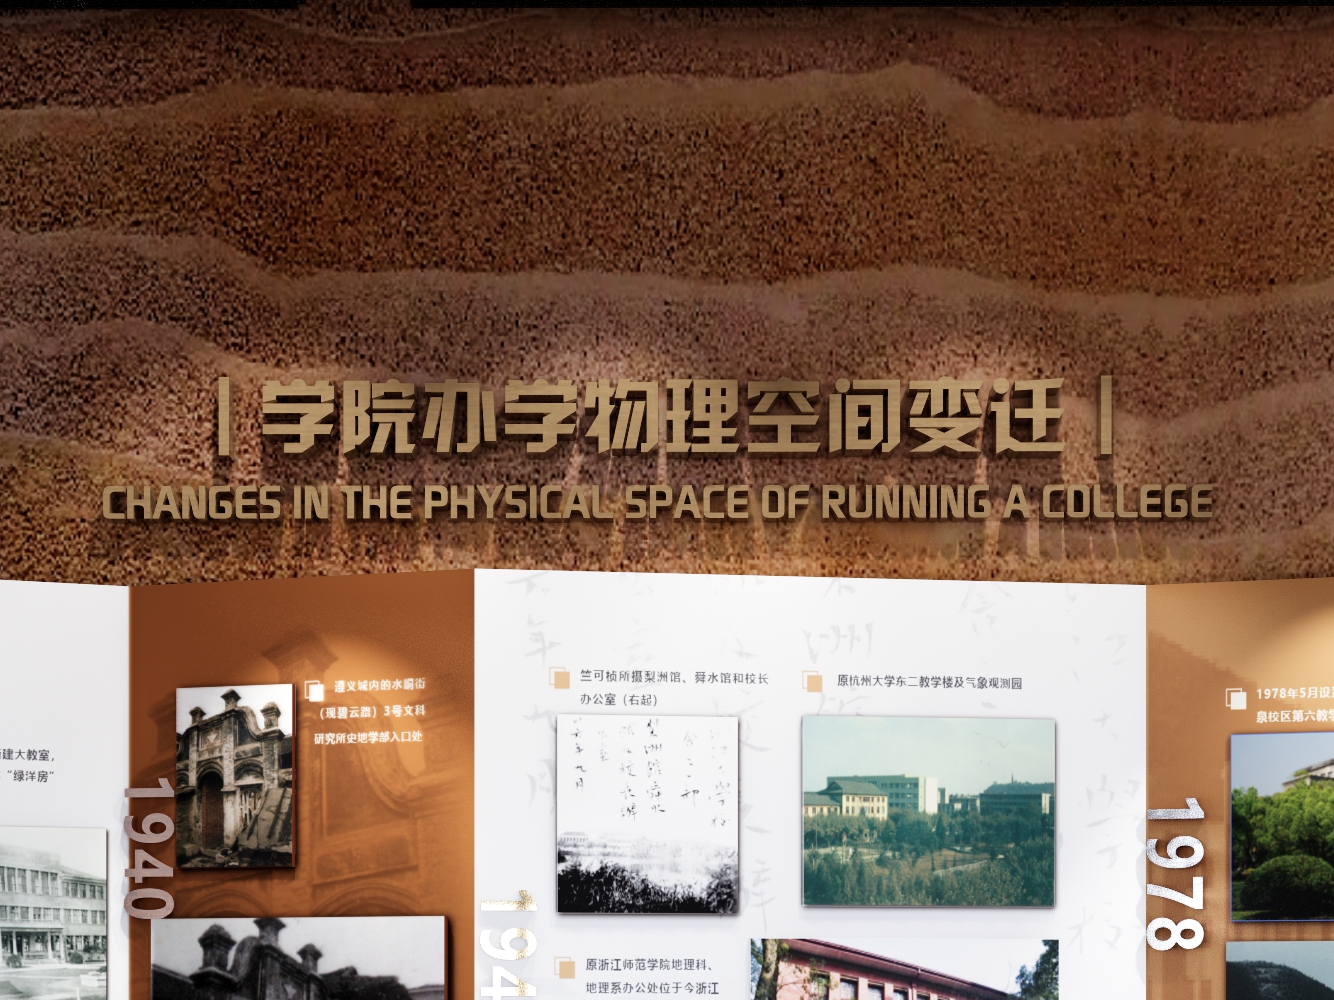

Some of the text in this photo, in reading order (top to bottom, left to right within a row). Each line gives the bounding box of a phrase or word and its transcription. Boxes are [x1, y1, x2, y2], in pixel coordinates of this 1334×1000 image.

[263, 377, 1066, 455] 学院办学物理空间变迁
[102, 485, 1214, 521] CHANGES IN THE PHYSICAL SPACE OF RUNNING A COLLEGE
[580, 669, 769, 685] 竺可桢所摄梨洲馆、舜水馆和校长
[837, 674, 1023, 690] 原杭州大学东二教学楼及气象观测园
[580, 693, 658, 707] 办公室（右起）
[314, 730, 423, 745] 研究所史地学部入口处
[124, 777, 175, 919] 1940
[1146, 797, 1205, 951] 1978
[586, 958, 714, 971] 原浙江师范学院地理科、
[586, 982, 720, 995] 地理系办公处位于今浙江
